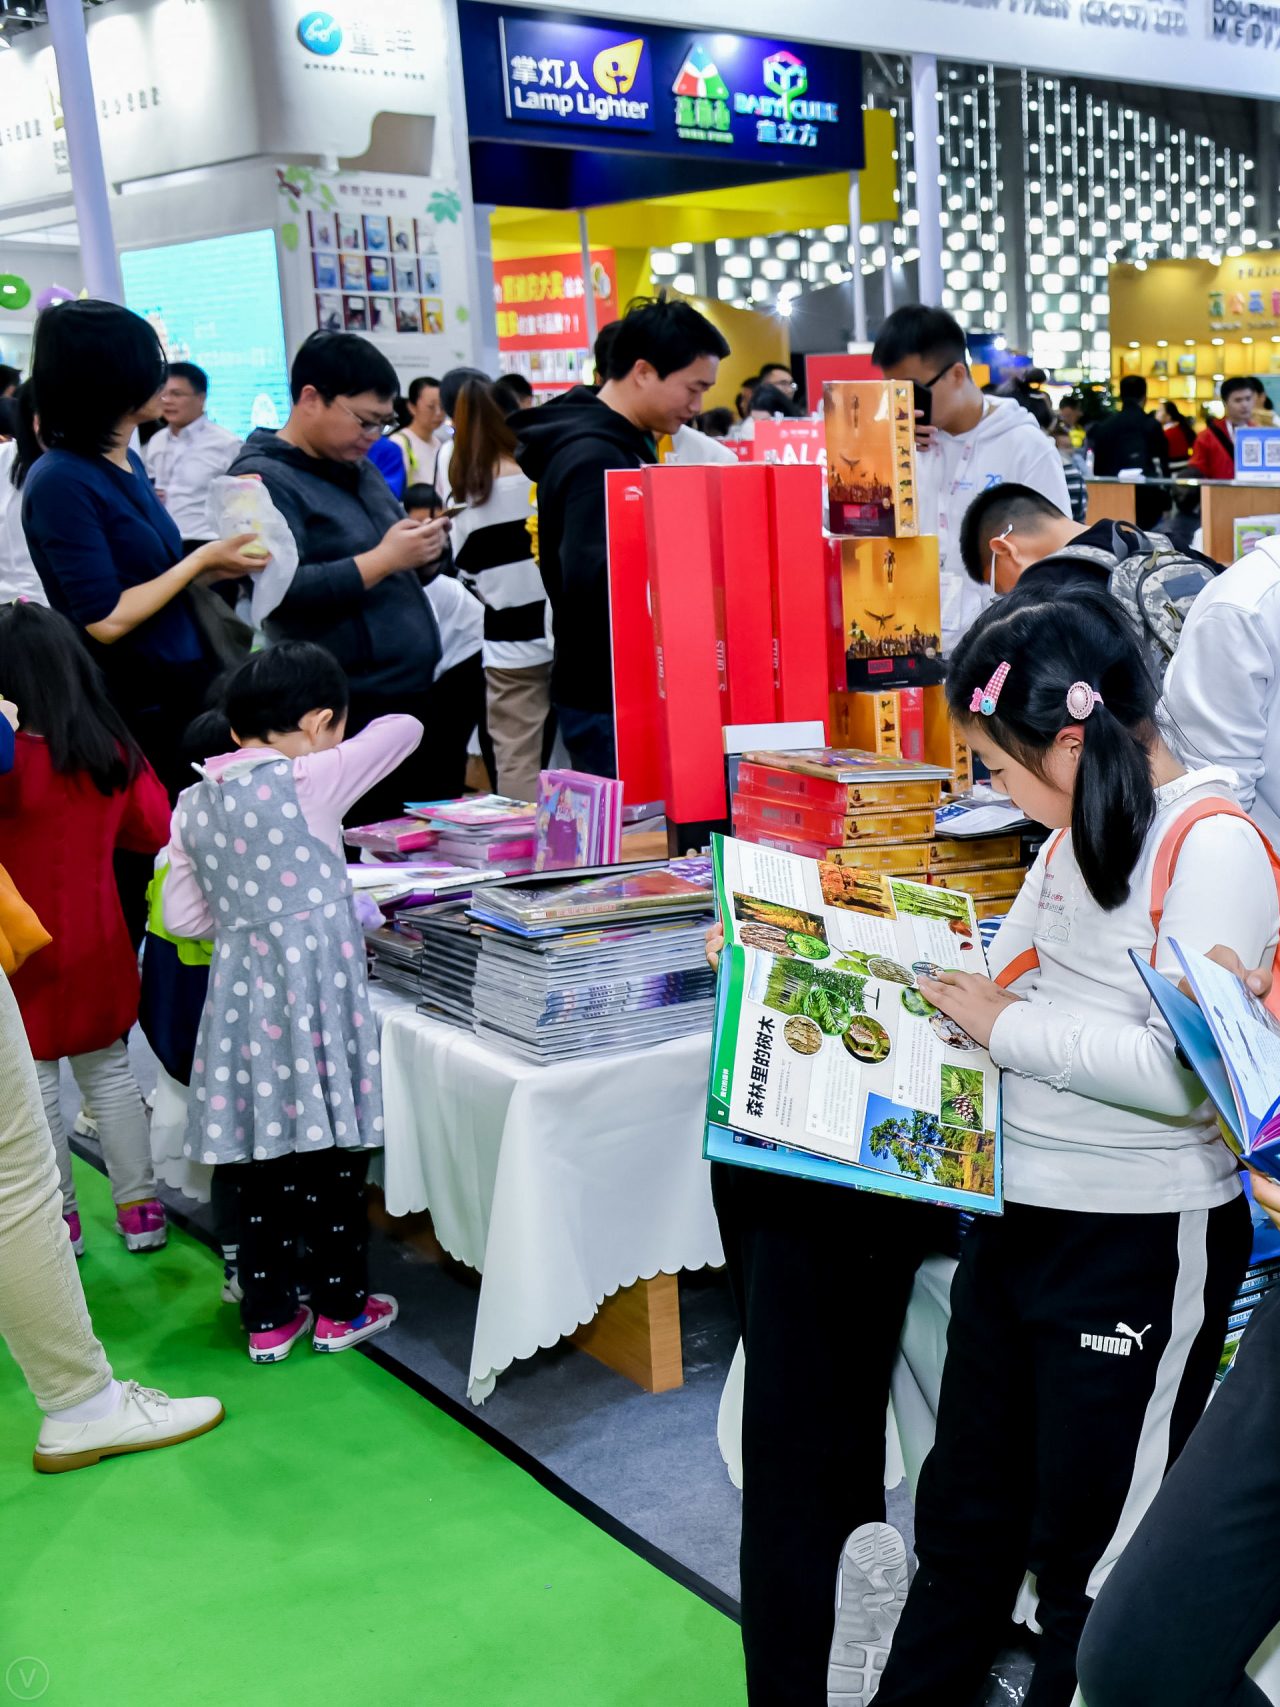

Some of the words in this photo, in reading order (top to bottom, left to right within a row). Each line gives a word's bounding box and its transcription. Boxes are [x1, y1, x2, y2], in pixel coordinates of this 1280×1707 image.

[511, 55, 589, 90] 掌灯人
[514, 86, 574, 117] Lamp
[576, 92, 649, 121] Lighter
[756, 119, 818, 147] 童立方
[746, 1016, 776, 1118] 森林里的树木
[1080, 1332, 1132, 1356] PUMA
